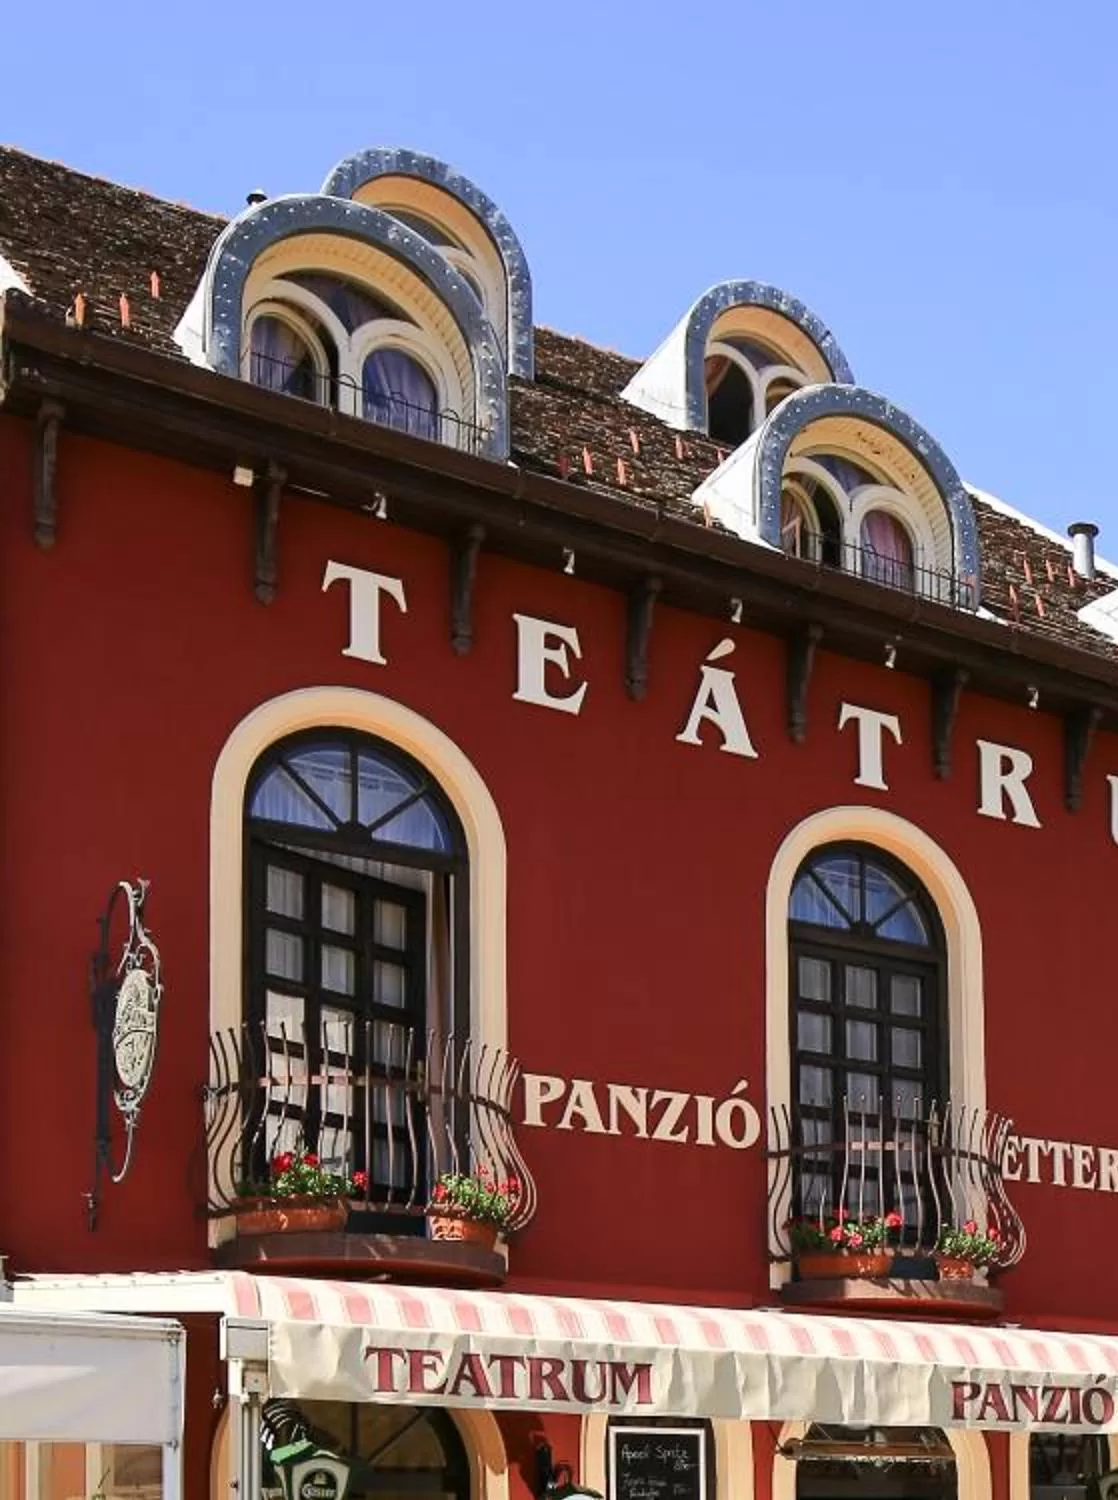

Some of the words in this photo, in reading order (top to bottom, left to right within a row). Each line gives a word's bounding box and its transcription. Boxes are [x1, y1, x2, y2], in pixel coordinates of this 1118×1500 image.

[520, 1072, 762, 1150] PANZIÓ
[363, 1345, 654, 1405] TEATRUM
[950, 1373, 1116, 1426] PANZIÓ
